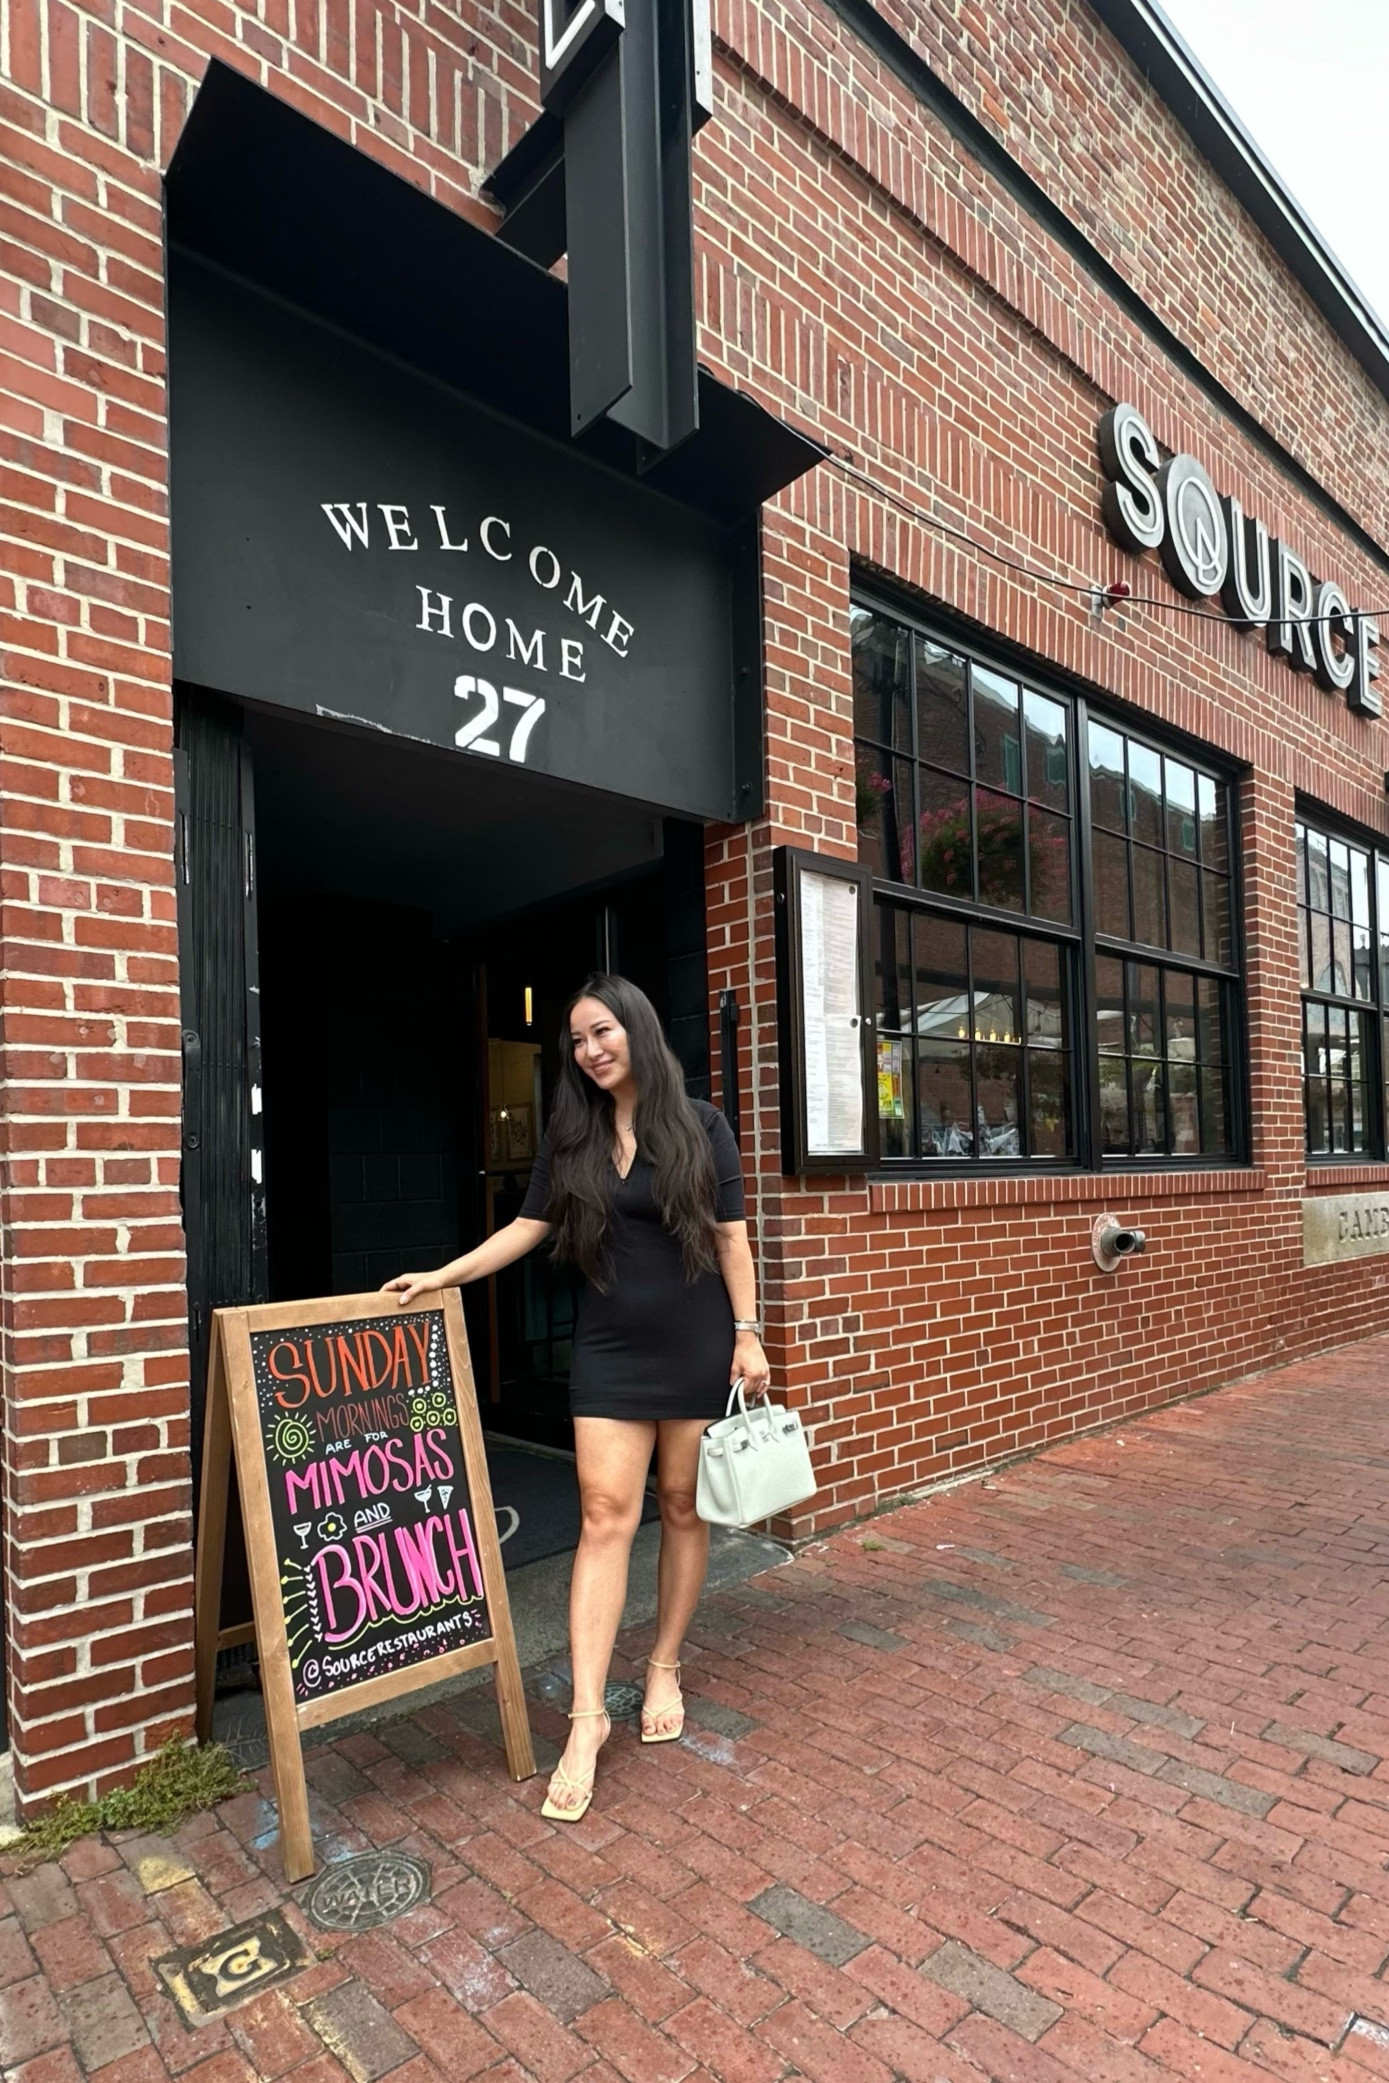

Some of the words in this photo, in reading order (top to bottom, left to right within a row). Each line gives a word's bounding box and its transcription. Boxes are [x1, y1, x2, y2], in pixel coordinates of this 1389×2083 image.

[320, 502, 635, 659] WELCOME
[1101, 402, 1383, 719] SOURCE
[415, 584, 587, 683] HOME
[453, 674, 546, 764] 27
[267, 1321, 432, 1409] SUNDAY
[316, 1393, 410, 1442] MORNINGS
[324, 1438, 353, 1456] ARE
[364, 1430, 389, 1444] FOR
[284, 1428, 455, 1516] MIMOSAS
[353, 1501, 391, 1527] AND
[308, 1508, 484, 1643] BRUNCH
[302, 1611, 473, 1687] @SOURCERESTAURANTS
